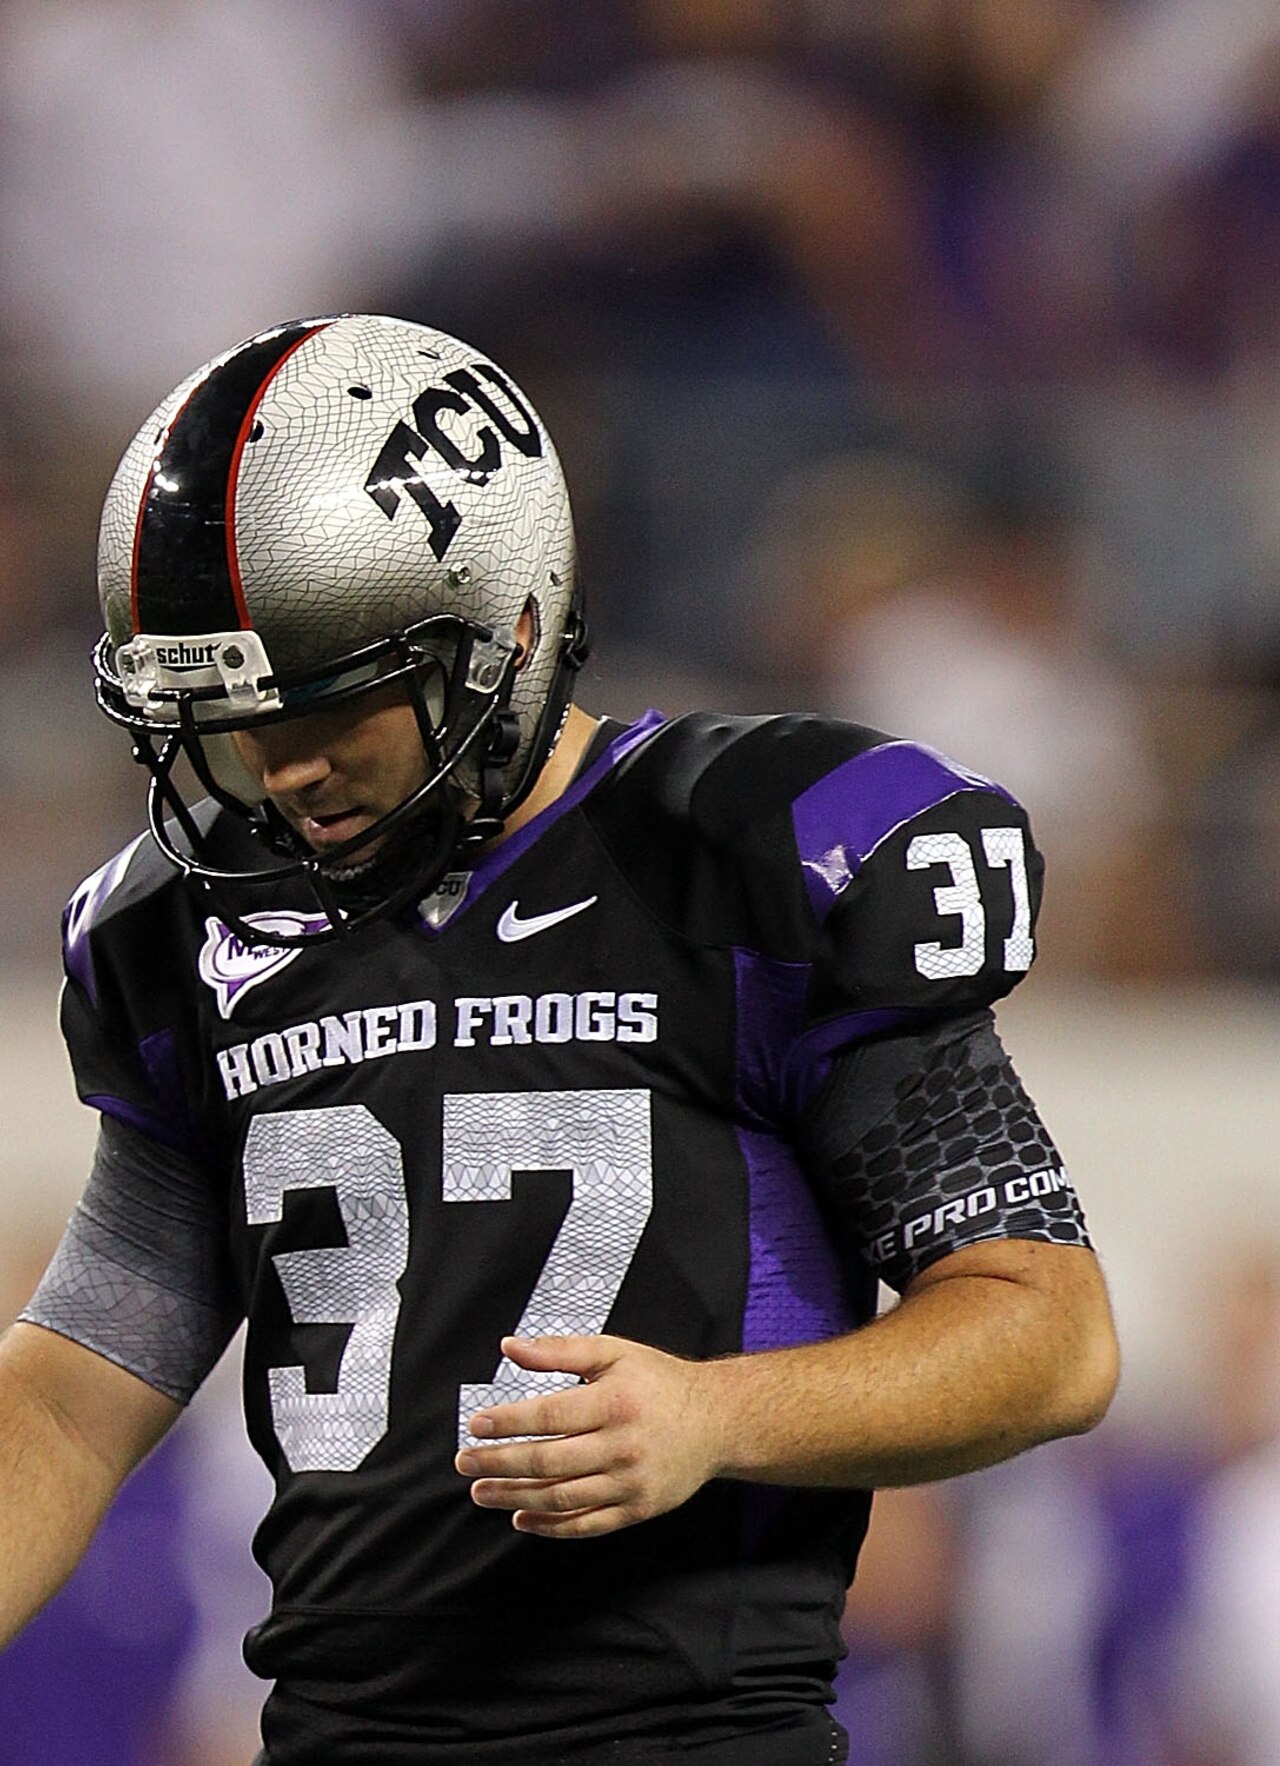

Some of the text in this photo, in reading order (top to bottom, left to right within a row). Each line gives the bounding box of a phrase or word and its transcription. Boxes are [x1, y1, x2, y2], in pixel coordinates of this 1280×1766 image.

[363, 364, 543, 562] TCU
[157, 643, 223, 664] schut
[907, 828, 1034, 980] 37
[216, 991, 658, 1099] HORNED FROGS
[242, 1088, 653, 1473] 37
[904, 1186, 997, 1250] PRO
